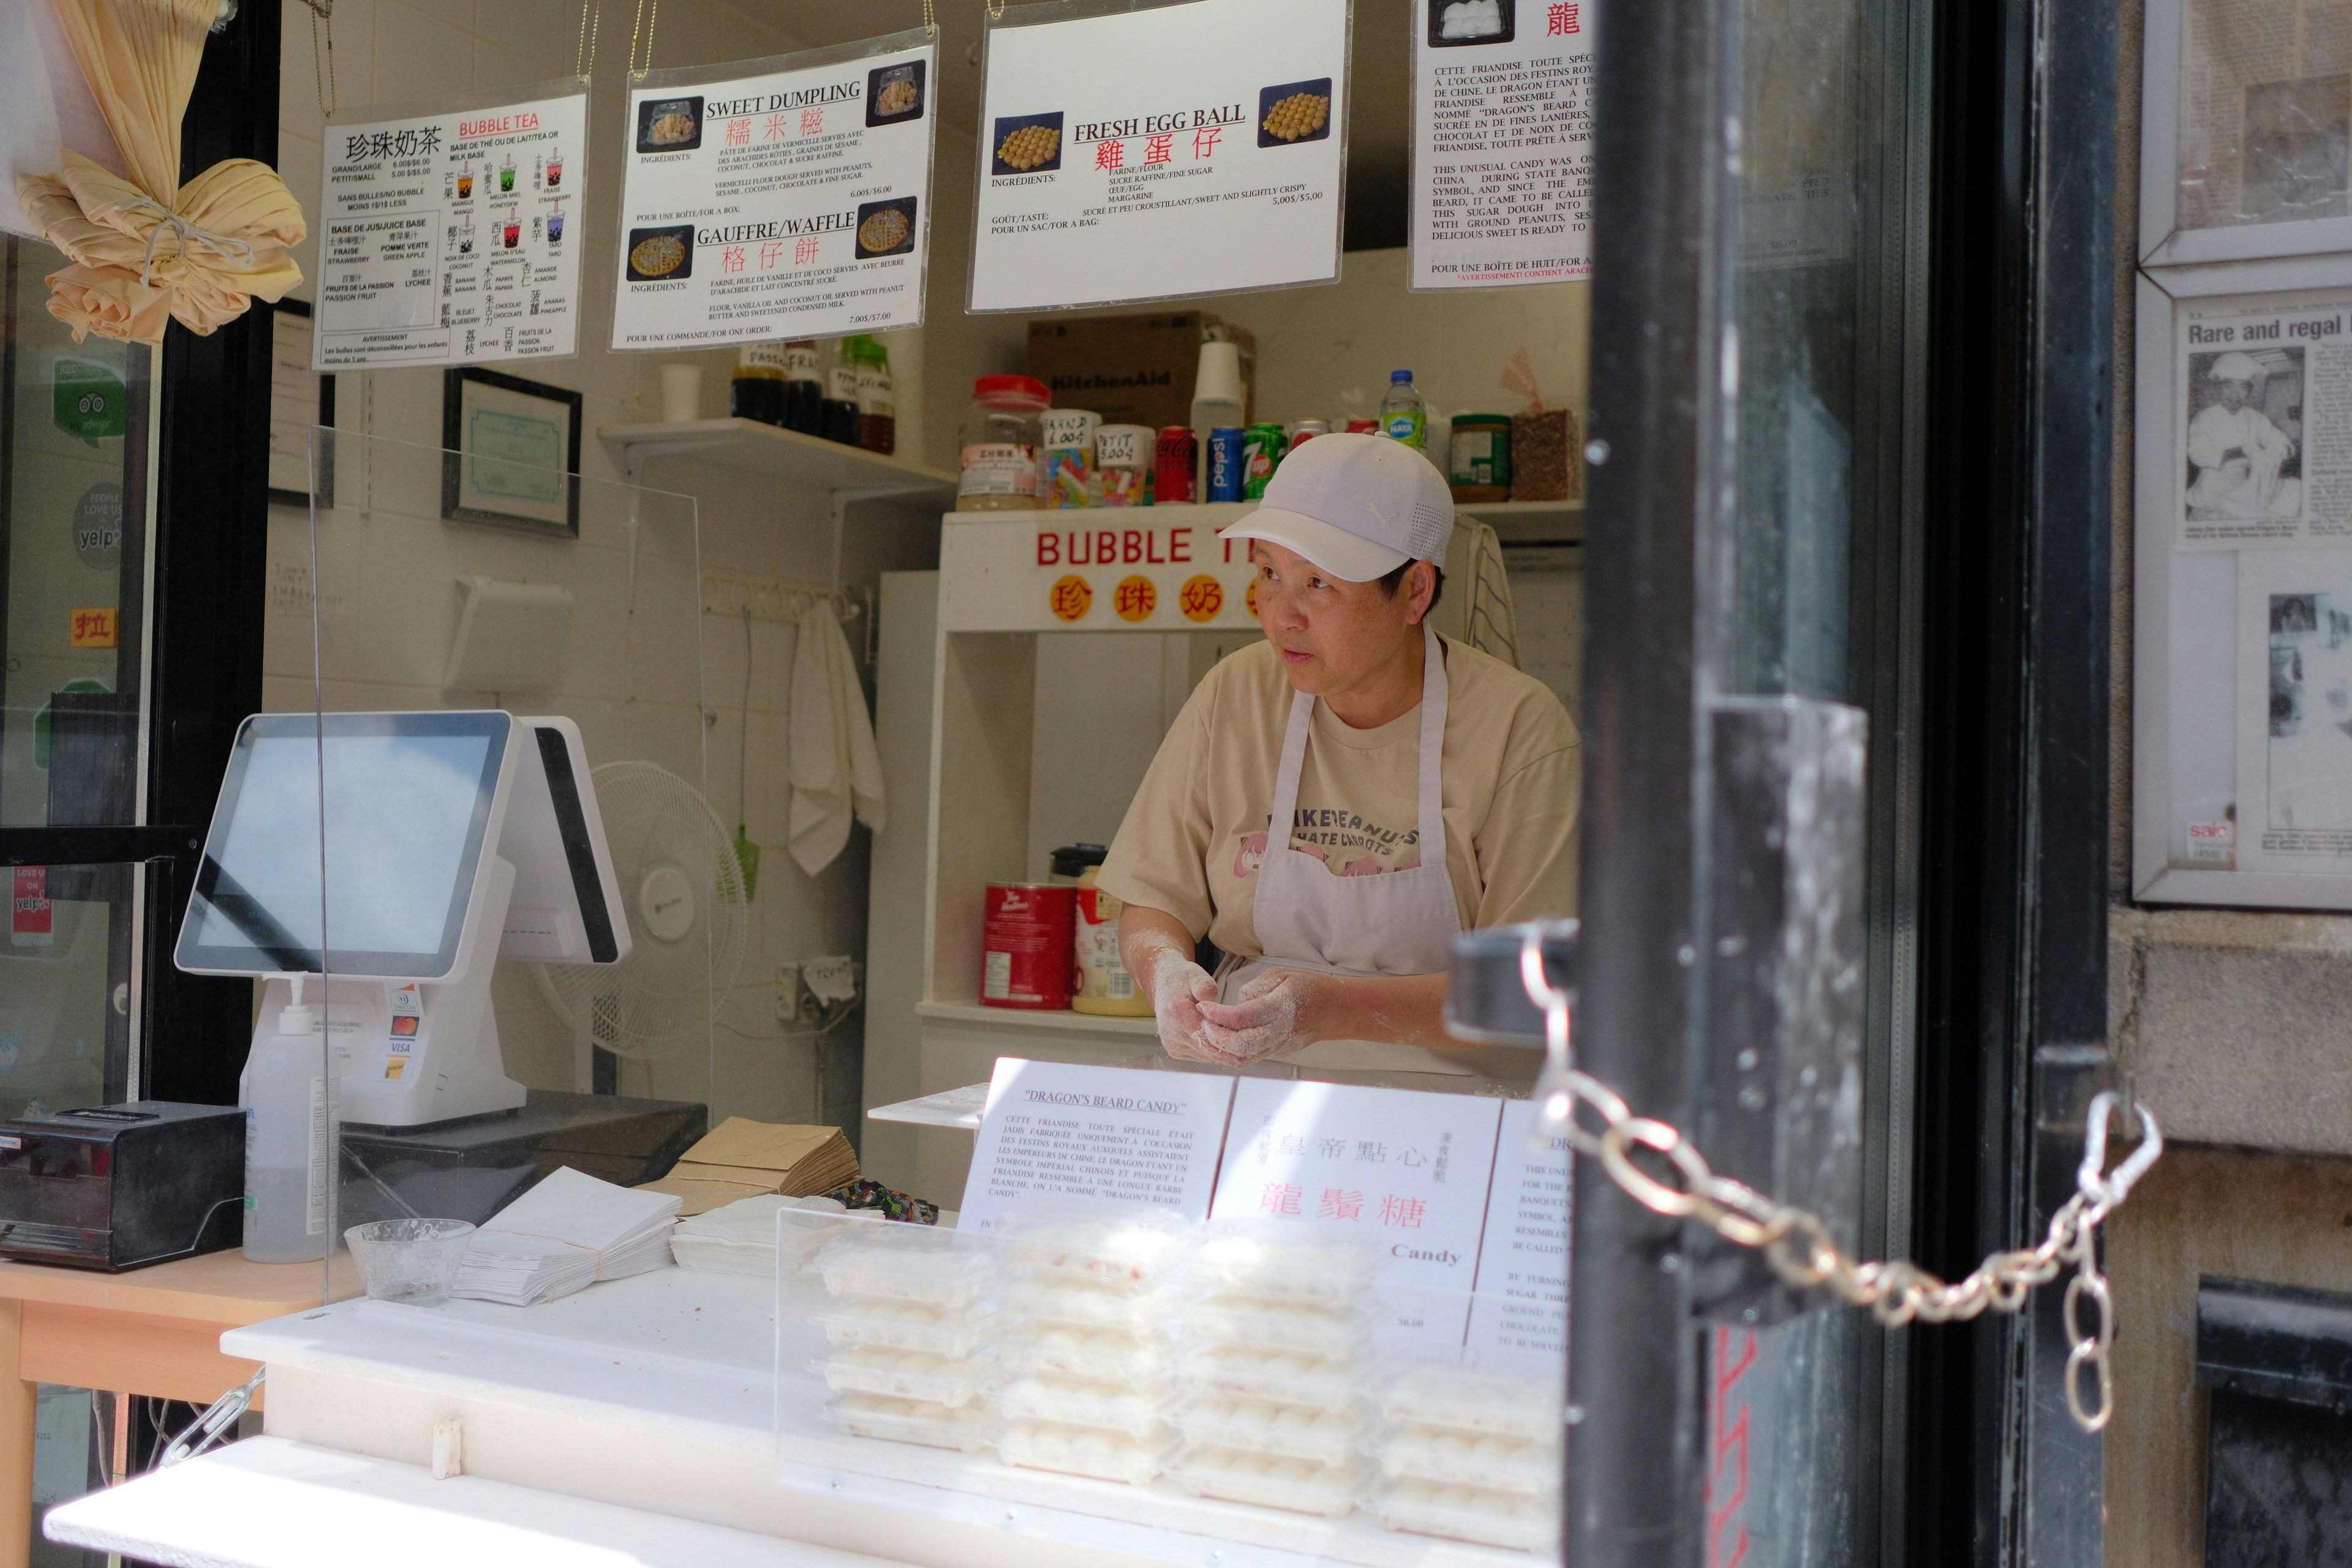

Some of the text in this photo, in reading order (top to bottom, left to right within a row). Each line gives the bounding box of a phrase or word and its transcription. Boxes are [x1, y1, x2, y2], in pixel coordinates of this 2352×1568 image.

[1547, 2, 1580, 37] 龍
[1434, 58, 1562, 75] CETTE FRIANDISE TOUTE
[706, 81, 860, 118] SWEET DUMPLING
[459, 113, 538, 136] BUBBLE TEA
[1074, 104, 1245, 141] FRESH EGG BALL
[346, 126, 442, 162] 珍珠奶茶
[450, 143, 467, 152] BASE
[480, 139, 493, 148] THÉ
[517, 132, 547, 143] LAIT/TEA
[467, 151, 484, 159] BASE
[1095, 127, 1222, 172] 雞蛋仔
[393, 158, 430, 168] 6.00$/$6.00
[641, 153, 692, 164] INGRÉDIENTS:
[1460, 162, 1506, 172] UNUSUAL
[1510, 159, 1545, 168] CANDY
[1550, 157, 1571, 165] WAS
[332, 162, 381, 173] GRAND/LARGE
[1109, 164, 1164, 176] FARINE/FLOUR
[331, 173, 375, 183] PETIT/SMALL
[992, 175, 1055, 187] INGRÉDIENTS:
[1109, 167, 1212, 185] SUCRE RAFFINE/FINE SUGAR
[358, 190, 396, 200] BULLES/NO
[397, 187, 424, 197] BUBBLE
[850, 186, 892, 197] 6.00$/$6.00
[1109, 184, 1144, 194] ŒUF/EGG
[1082, 207, 1106, 216] SUCRÉ
[1135, 194, 1220, 210] CROUSTILLANT/SWEET
[1240, 187, 1278, 198] SLIGHTLY
[1280, 184, 1306, 193] CRISPY
[1108, 192, 1153, 203] MARGARINE
[1272, 192, 1323, 205] 5,00$/$5,00
[347, 202, 369, 211] MOINS
[371, 200, 388, 209] 1$/1$
[676, 208, 714, 218] BOÎTE/FOR
[992, 213, 1049, 224] GOÛT/TASTE:
[365, 221, 404, 231] JUS/JUICE
[405, 219, 426, 228] BASE
[697, 211, 855, 244] GAUFFRE/WAFFLE
[1031, 221, 1068, 231] SAC/FOR
[1079, 218, 1099, 227] BAG:
[380, 243, 405, 252] POMME
[327, 256, 369, 265] STRAWBERRY
[721, 236, 819, 273] 格仔餅
[491, 257, 526, 266] WATERMELON
[1484, 262, 1513, 270] BOÎTE
[1531, 258, 1580, 268] HUIT/FOR
[405, 278, 431, 287] LYCHEE
[631, 282, 687, 292] INGRÉDIENTS:
[849, 312, 891, 323] 7.00$/$7.00
[666, 330, 726, 340] COMMANDE/FOR
[2188, 325, 2234, 344] Rare
[2242, 319, 2280, 341] and
[2289, 314, 2341, 341] regal
[362, 334, 407, 342] AVERTISSEMENT
[1051, 371, 1170, 390] KitchenAid
[1390, 424, 1414, 433] NAYA
[1098, 434, 1133, 447] PETIT
[1213, 438, 1228, 487] pepsi
[80, 528, 113, 549] yelp
[1038, 528, 1192, 565] BUBBLE
[1054, 581, 1257, 619] 珍珠奶
[1341, 833, 1393, 856] CARROTS
[17, 897, 38, 910] yelp
[391, 1043, 410, 1052] VISA
[1093, 1096, 1133, 1109] BEARD
[1276, 1133, 1427, 1167] 皇帝點心
[1257, 1182, 1427, 1229] 龍鬚糖
[1391, 1243, 1461, 1267] Candy
